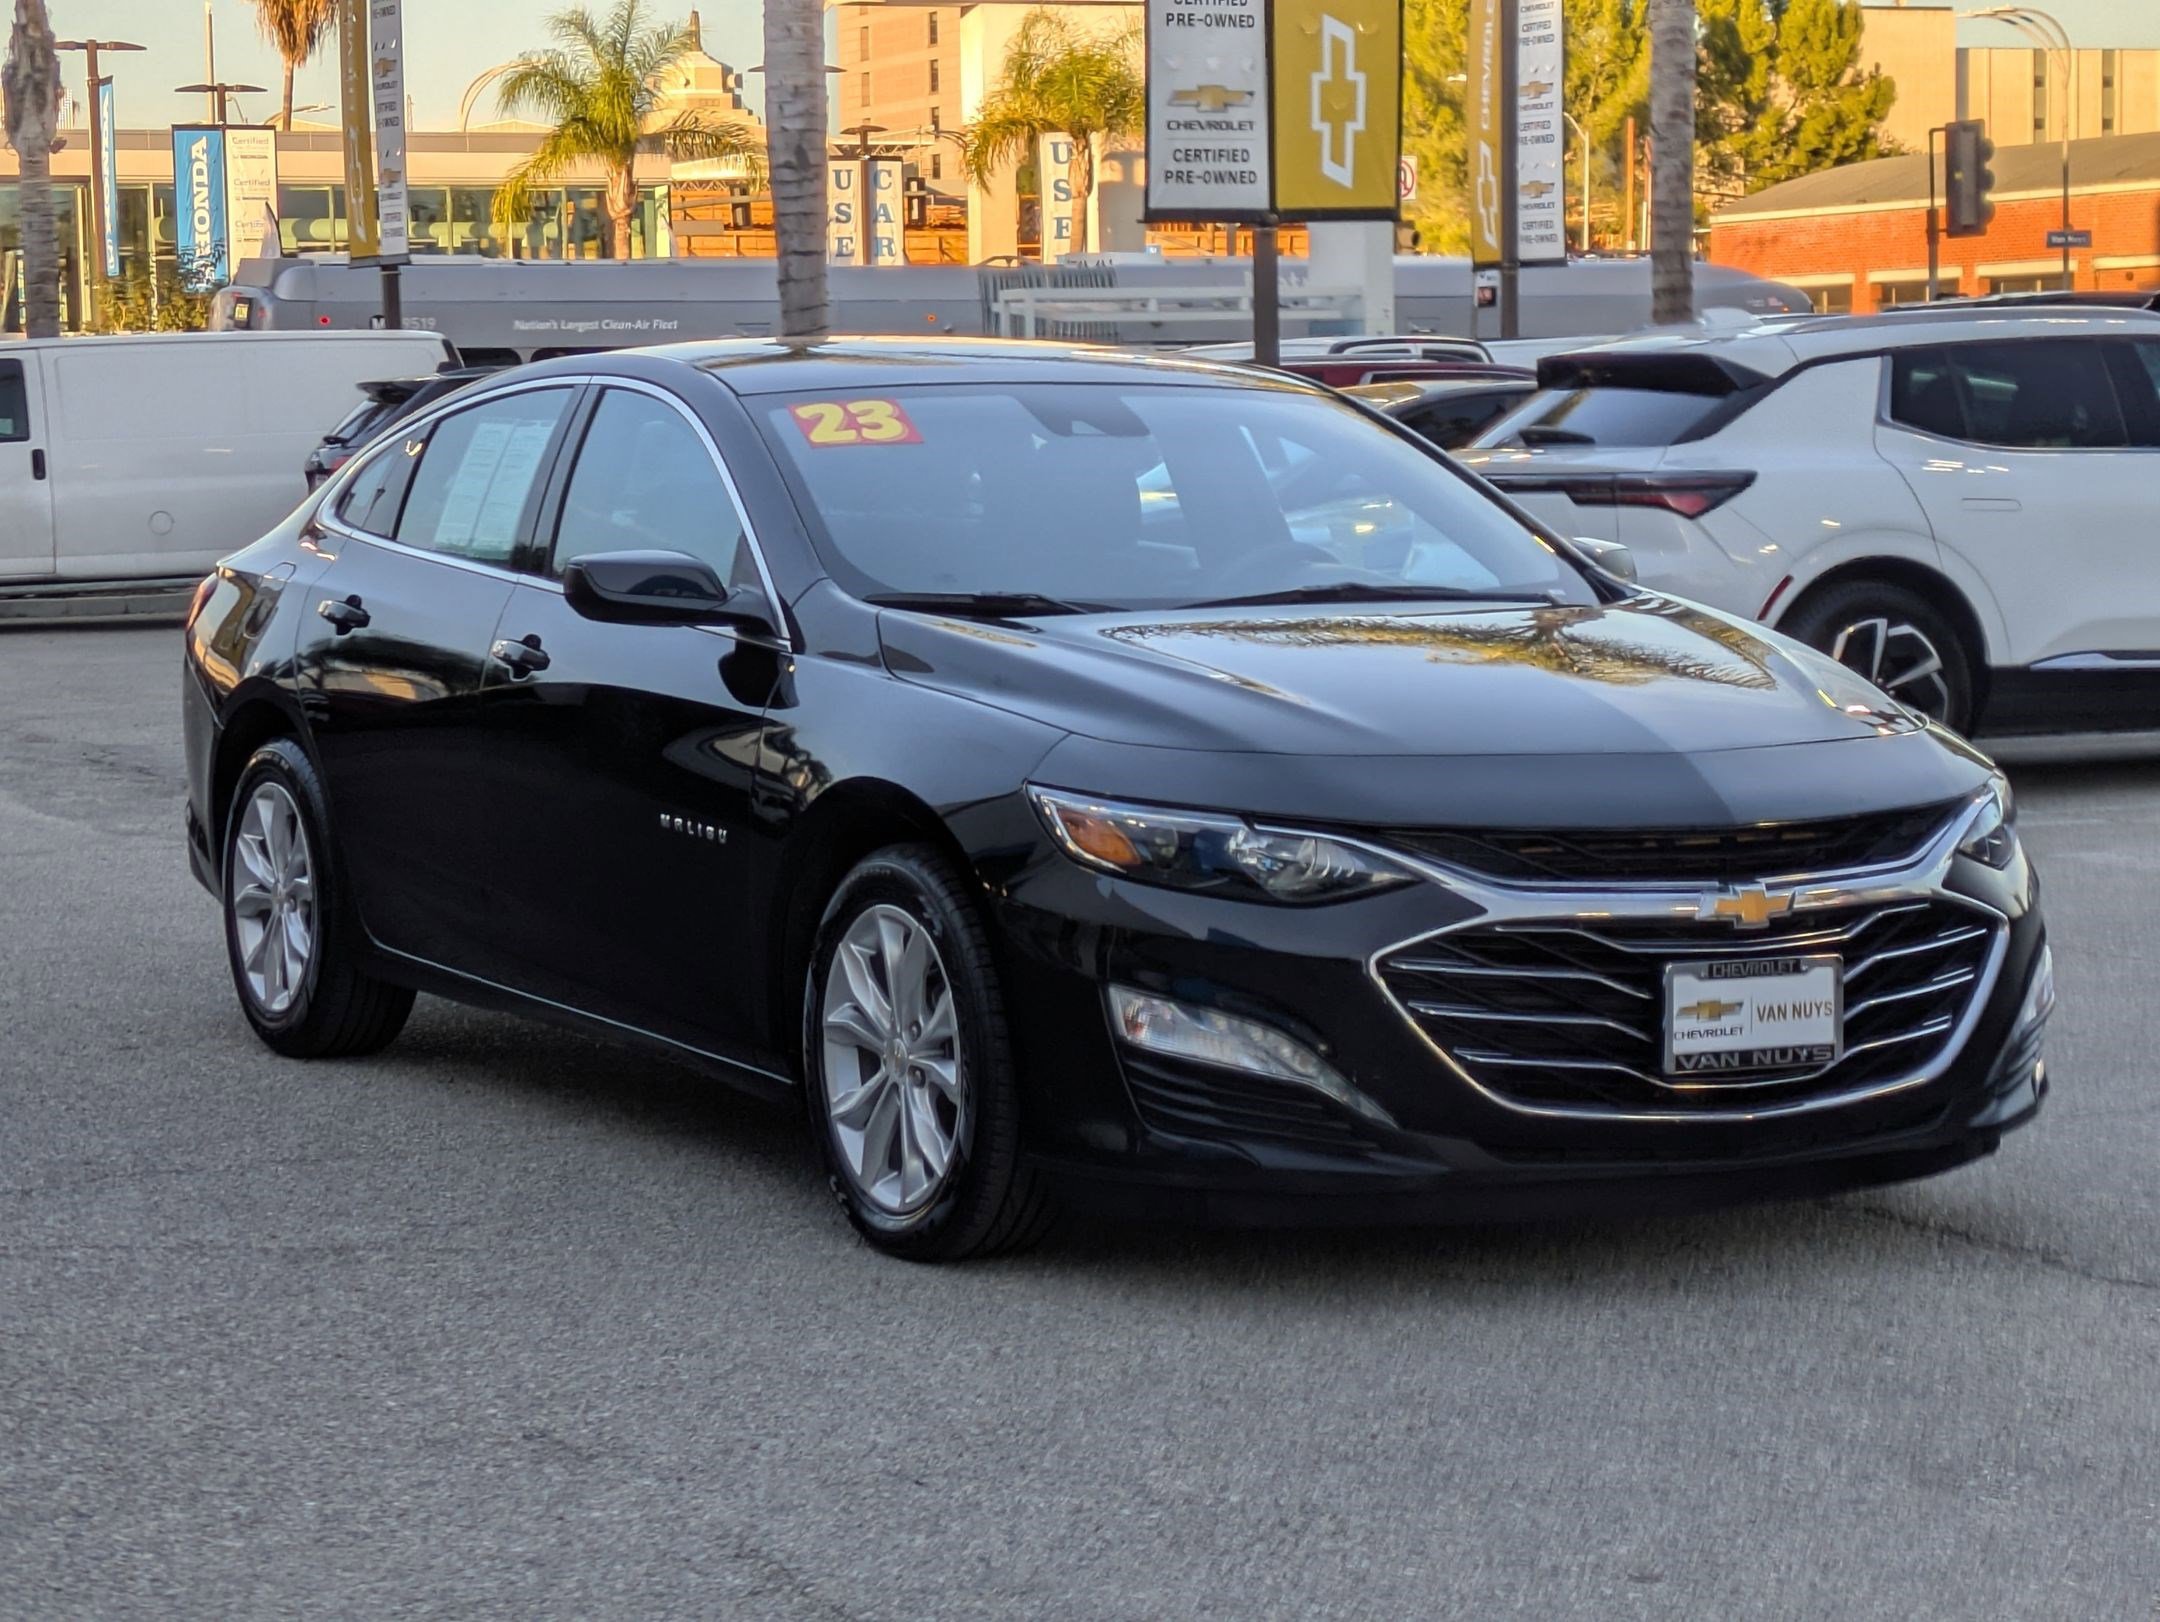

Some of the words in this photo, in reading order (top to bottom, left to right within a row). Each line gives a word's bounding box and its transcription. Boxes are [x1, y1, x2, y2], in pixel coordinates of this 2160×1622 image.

[1166, 13, 1255, 28] PRE-OWNED
[1167, 120, 1255, 131] CHEVROLET
[232, 137, 269, 145] Certified
[1173, 149, 1250, 163] CERTIFIED
[234, 178, 270, 186] Certified
[1164, 171, 1258, 185] PRE-OWNED
[191, 136, 211, 258] HONDA
[402, 317, 437, 329] 9519
[513, 320, 558, 330] Nation's
[560, 320, 599, 332] Largest
[601, 319, 650, 330] Clean-Air
[652, 319, 678, 330] Fleet
[795, 400, 908, 442] 23
[660, 813, 728, 844] MALIBU
[1712, 960, 1797, 978] CHEVROLET
[1757, 1004, 1788, 1024] VAN
[1792, 1000, 1833, 1019] NUYS
[1674, 1027, 1744, 1041] CHEVROLET
[1677, 1052, 1741, 1071] VAN
[1752, 1046, 1832, 1067] NUYS
